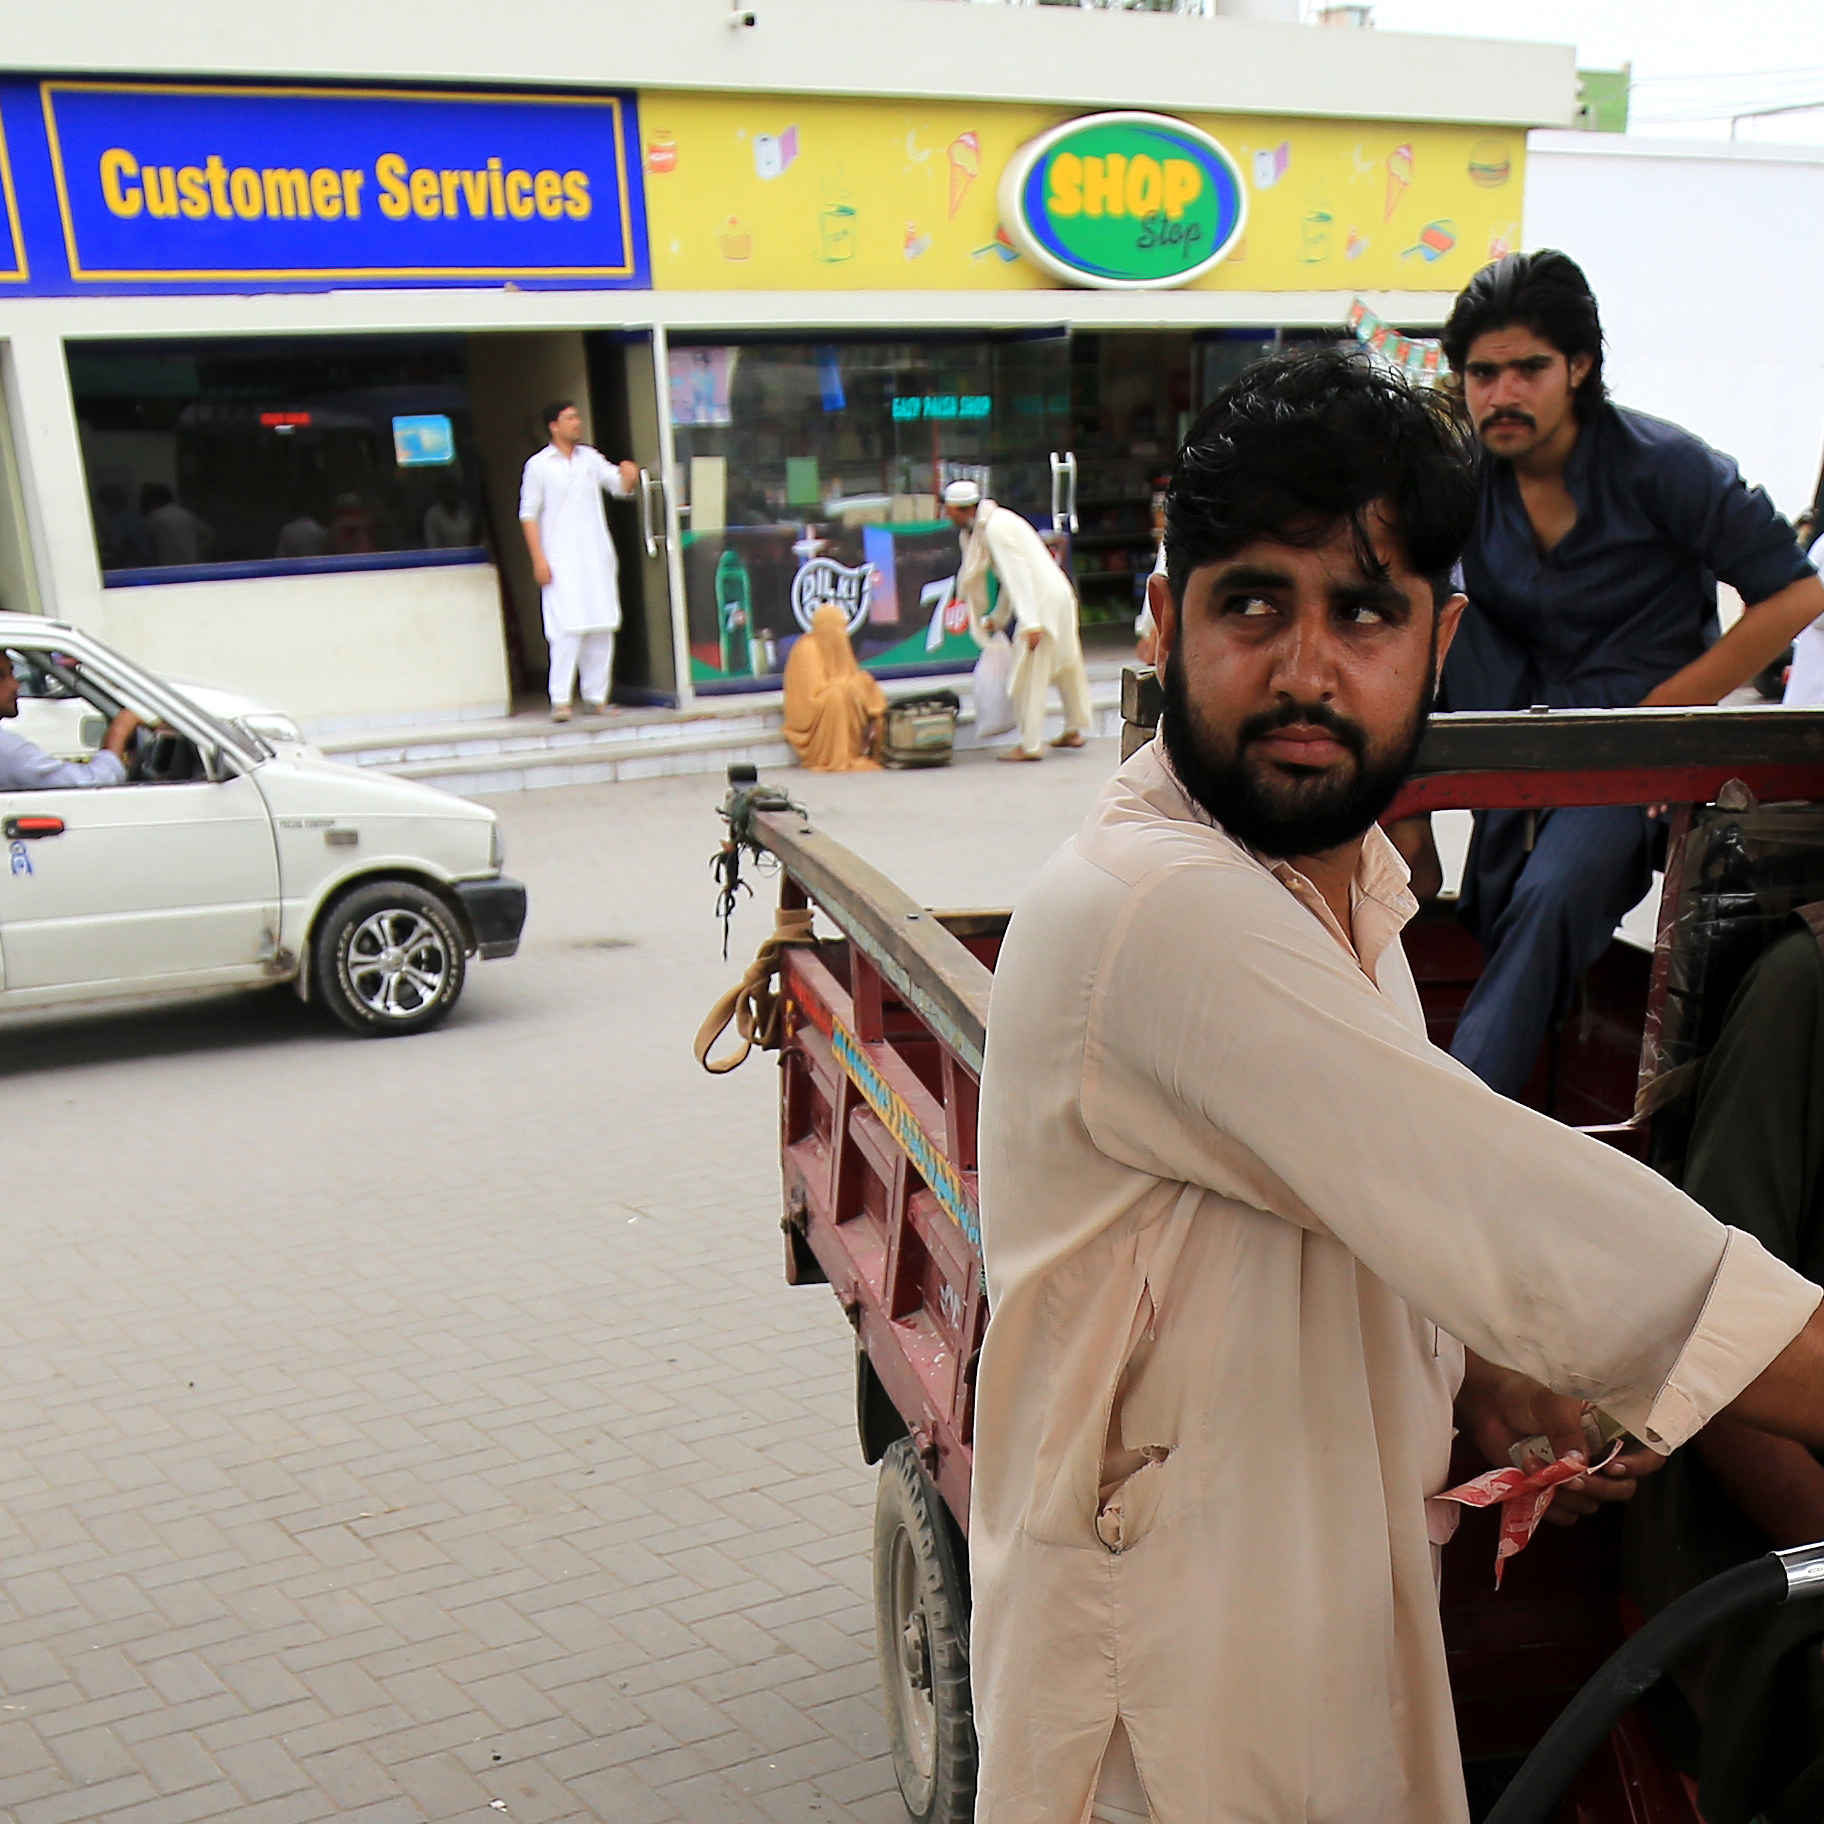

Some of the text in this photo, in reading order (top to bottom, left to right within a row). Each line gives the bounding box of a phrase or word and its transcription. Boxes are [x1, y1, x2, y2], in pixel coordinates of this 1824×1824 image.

[99, 147, 592, 220] Customer Services
[1048, 151, 1203, 219] SHOP
[1136, 209, 1203, 259] Stop
